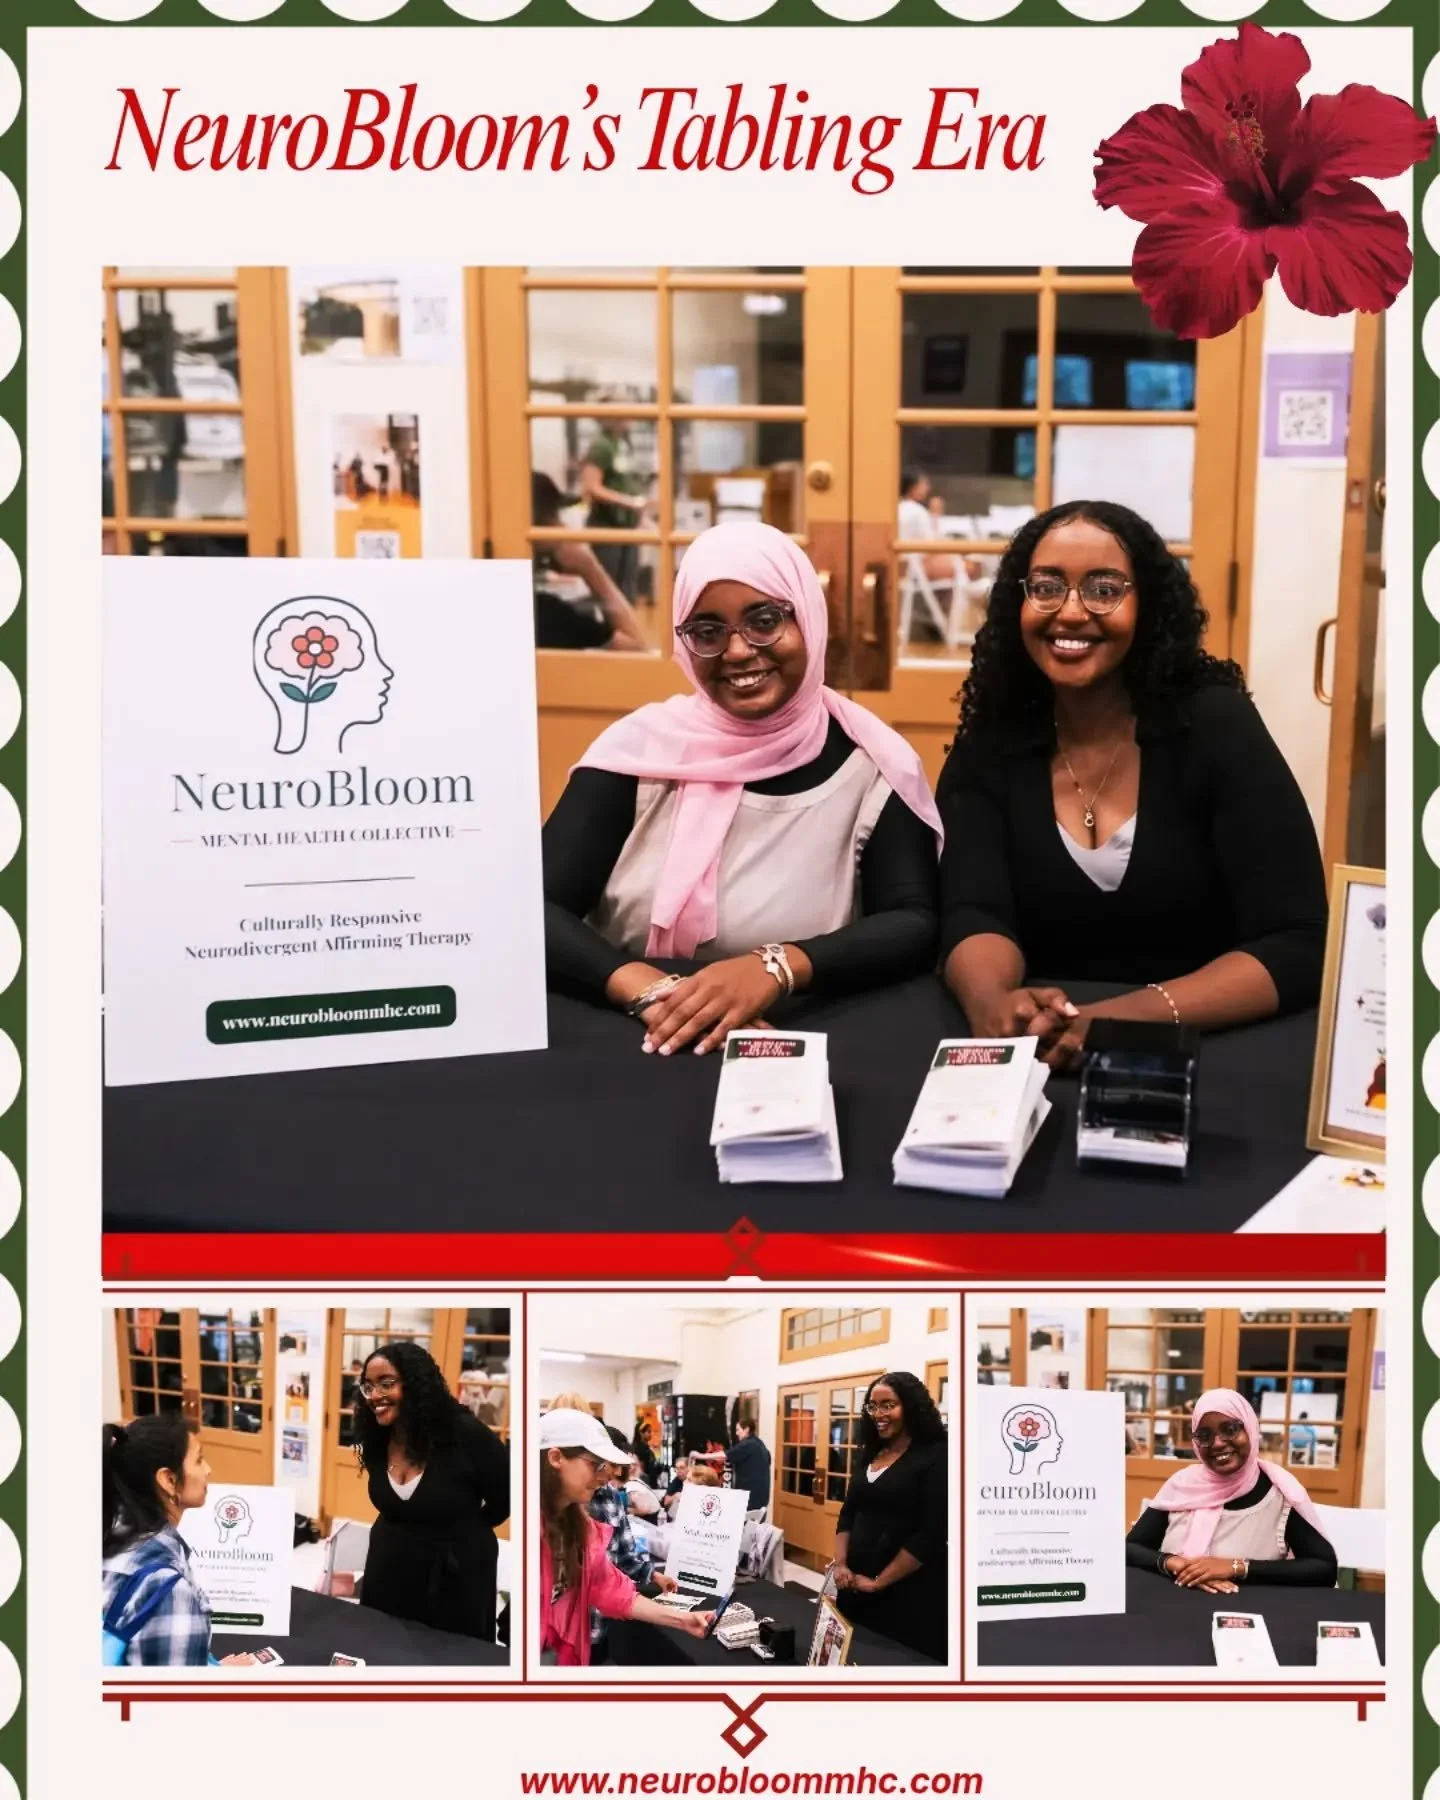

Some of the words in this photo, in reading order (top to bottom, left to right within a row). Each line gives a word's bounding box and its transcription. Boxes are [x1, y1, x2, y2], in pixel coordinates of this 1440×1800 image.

[171, 766, 474, 812] NeuroBloom
[201, 833, 272, 848] MENTAL
[277, 830, 344, 844] HEALTH
[350, 825, 454, 841] COLLECTIVE
[240, 914, 324, 933] Culturally
[330, 909, 422, 928] Responsive
[185, 940, 317, 959] Neurodivergent
[324, 934, 402, 951] Affirming
[406, 930, 472, 947] Therapy
[222, 1002, 441, 1030] www.neurobloommhc.com
[980, 1481, 1096, 1500] euroBloom
